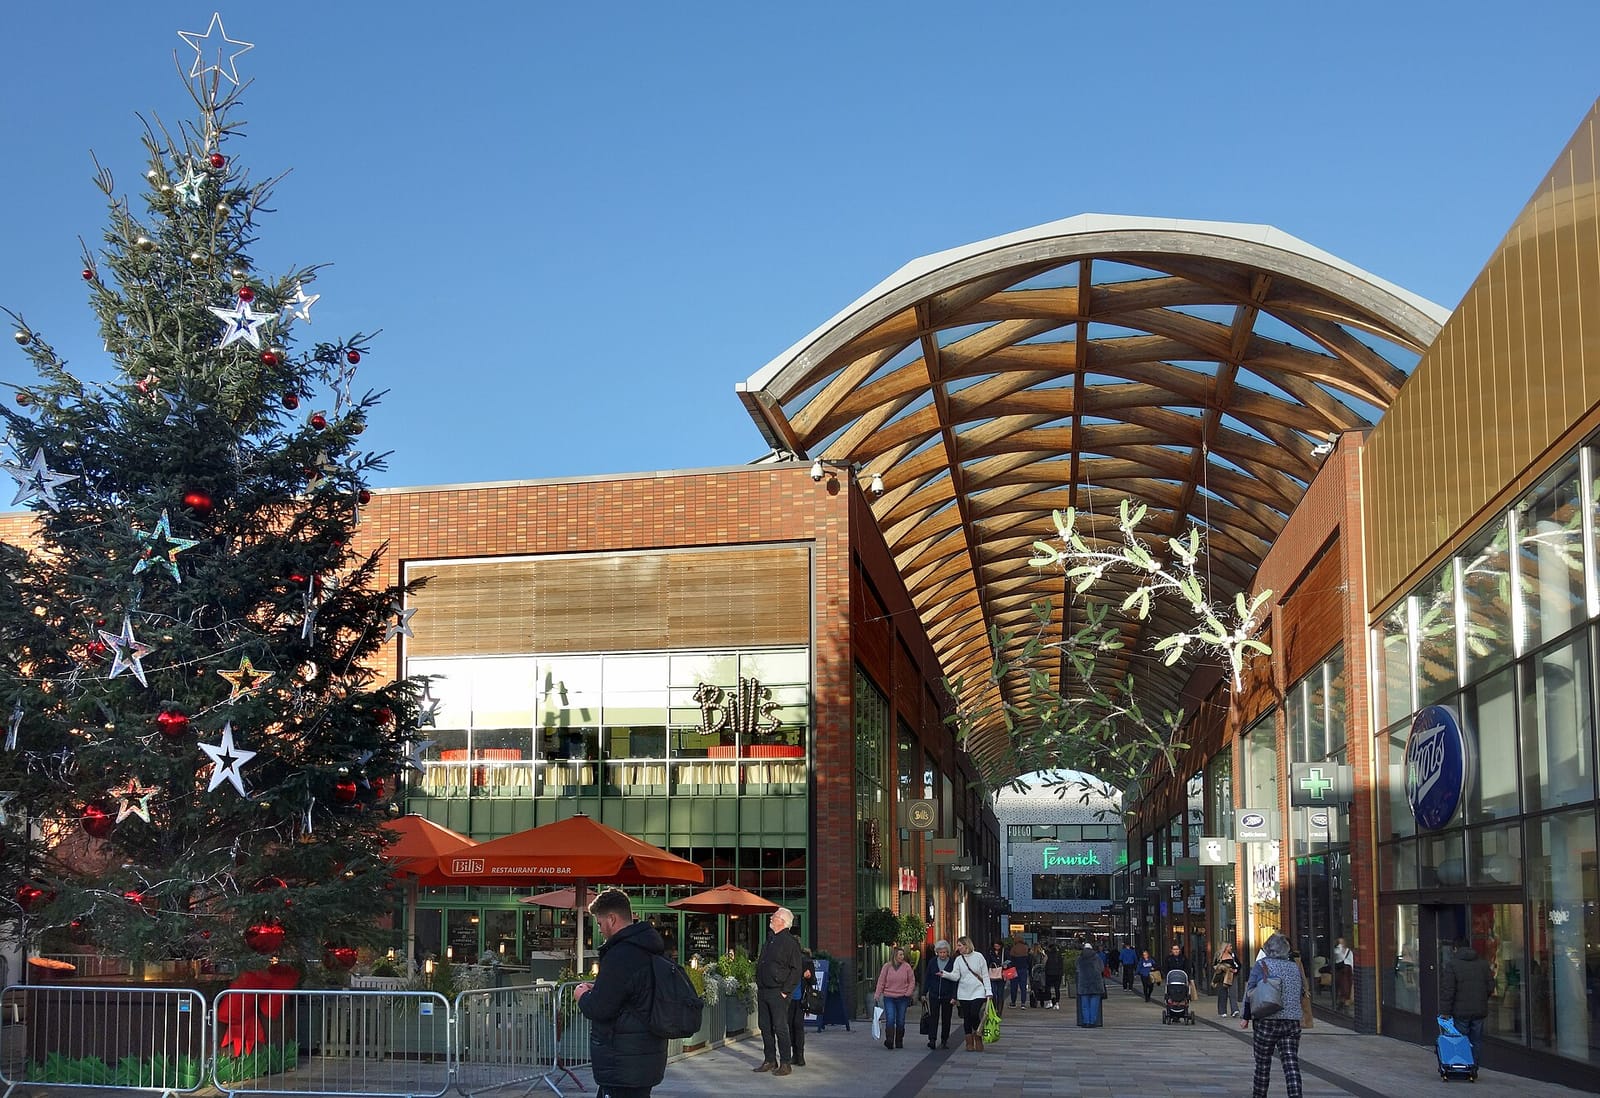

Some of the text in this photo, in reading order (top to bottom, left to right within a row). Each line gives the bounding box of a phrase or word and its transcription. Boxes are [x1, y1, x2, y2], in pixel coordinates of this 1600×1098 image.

[693, 677, 783, 735] Bill's
[1408, 723, 1446, 804] Boots
[1008, 826, 1031, 837] FUEGO
[455, 859, 482, 873] Bill's
[1042, 846, 1101, 870] Fenwick
